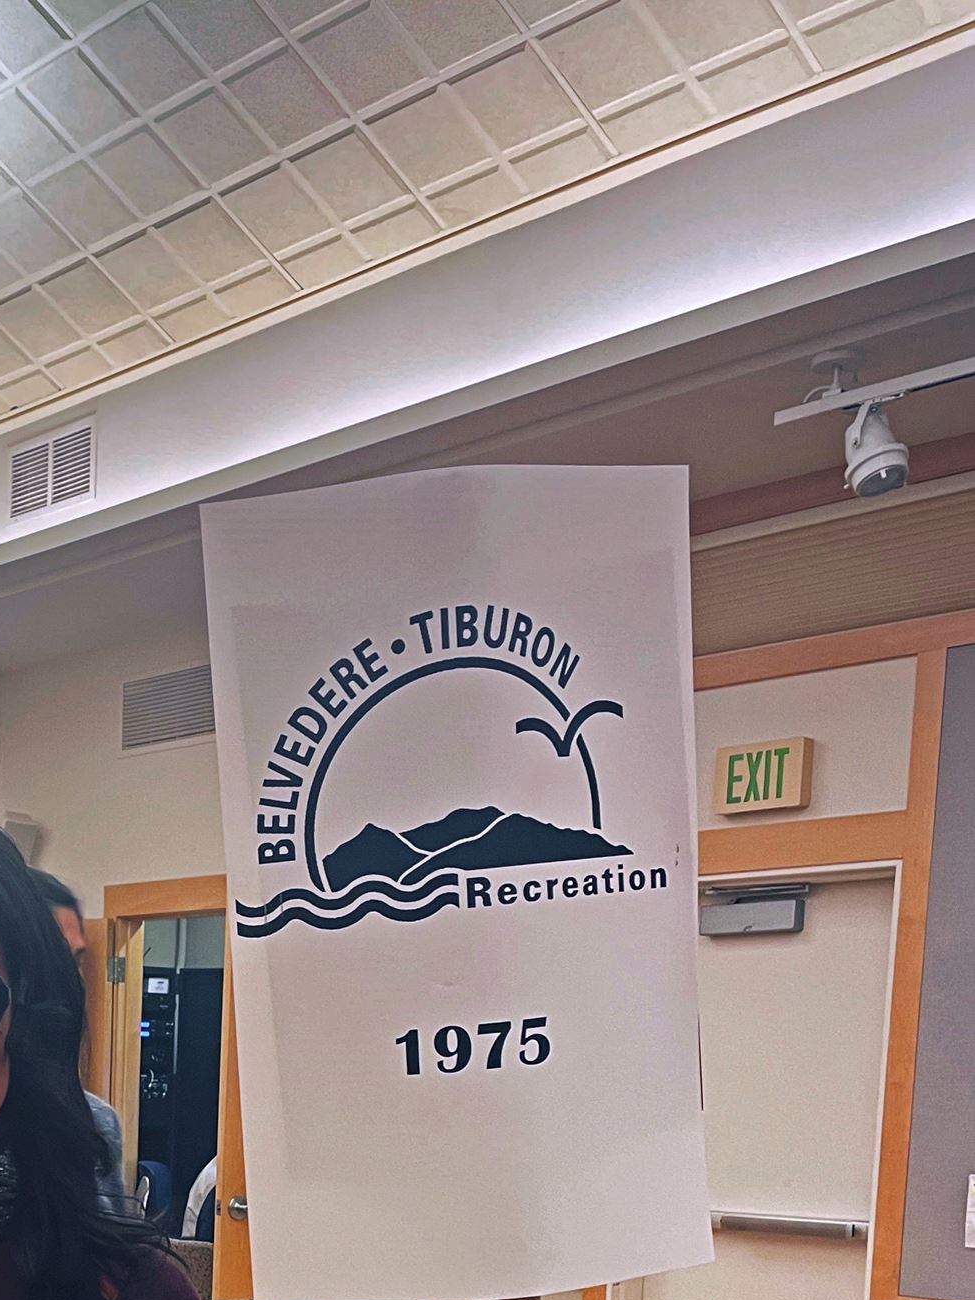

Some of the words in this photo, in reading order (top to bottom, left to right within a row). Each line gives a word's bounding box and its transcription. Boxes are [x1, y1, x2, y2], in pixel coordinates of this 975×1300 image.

[257, 639, 388, 864] BELVEDERE
[409, 604, 581, 689] TIBURON
[726, 747, 790, 804] EXIT
[467, 864, 668, 909] Recreation
[395, 1016, 551, 1076] 1975
